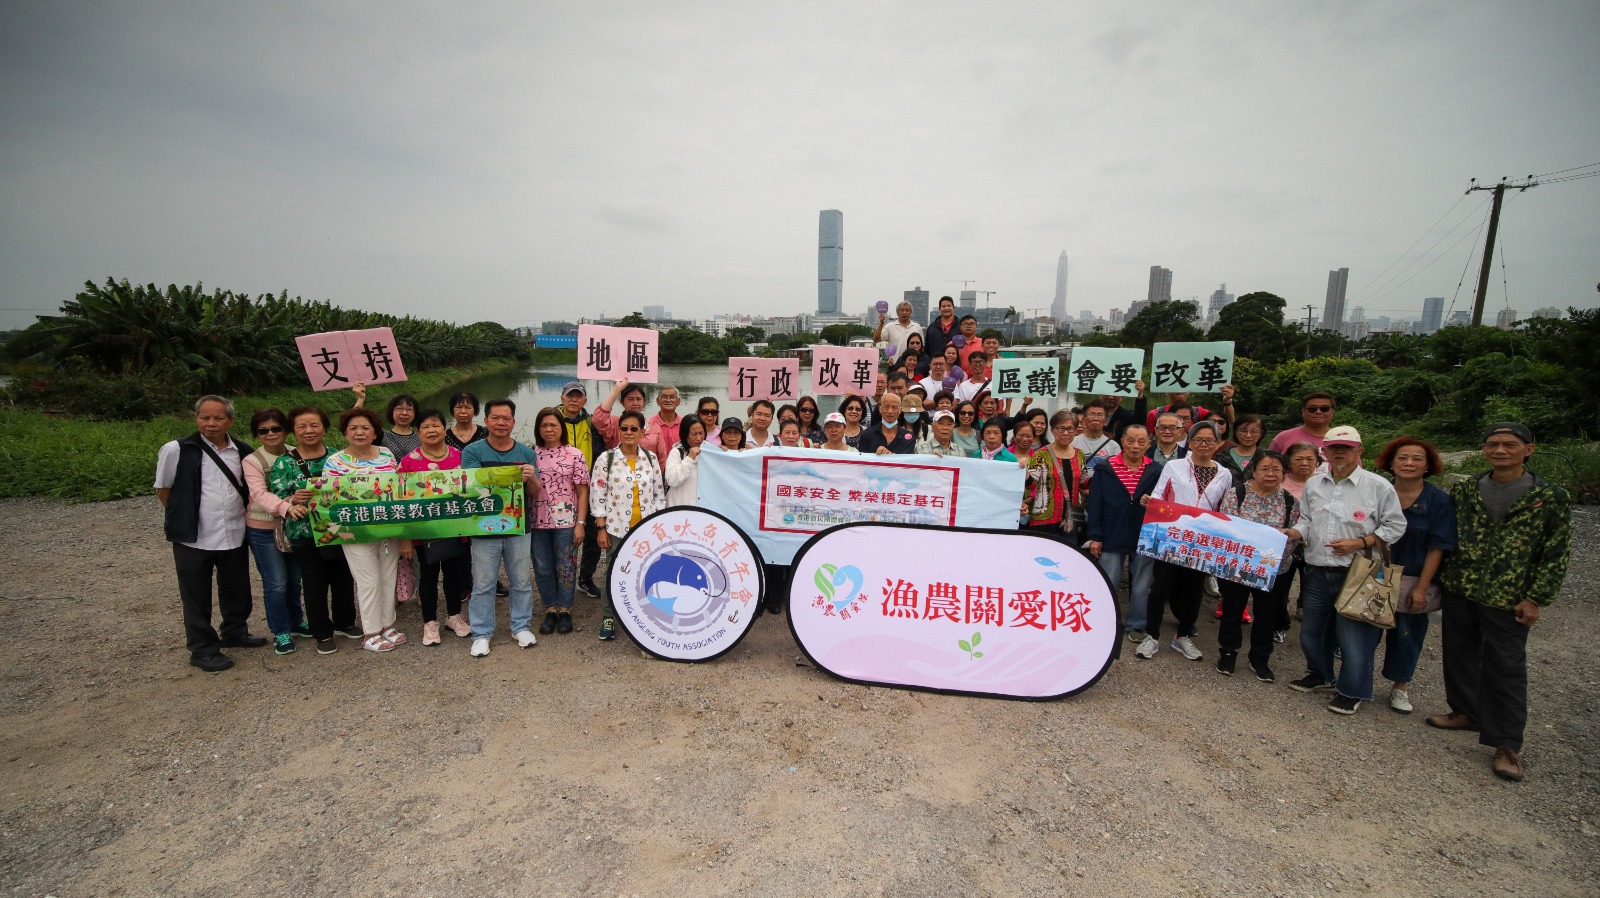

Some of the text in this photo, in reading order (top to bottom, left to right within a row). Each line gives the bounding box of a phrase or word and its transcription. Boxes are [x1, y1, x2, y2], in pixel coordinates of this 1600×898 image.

[311, 341, 393, 387] 支持
[586, 337, 649, 373] 地區
[736, 366, 791, 399] 行政
[819, 357, 873, 390] 改革
[998, 366, 1057, 398] 區議
[1072, 359, 1137, 394] 會要
[1155, 356, 1229, 389] 改革
[336, 497, 495, 523] 香港農業教育基金會
[776, 484, 945, 509] 國家安全 繁榮穩定基石
[1167, 525, 1257, 560] 完善選舉制度
[1178, 544, 1268, 577] 落實愛國者治港
[618, 580, 727, 651] SAI KUNG ANGLING YOUTH ASSOCIATION
[881, 577, 1093, 634] 漁農關愛隊
